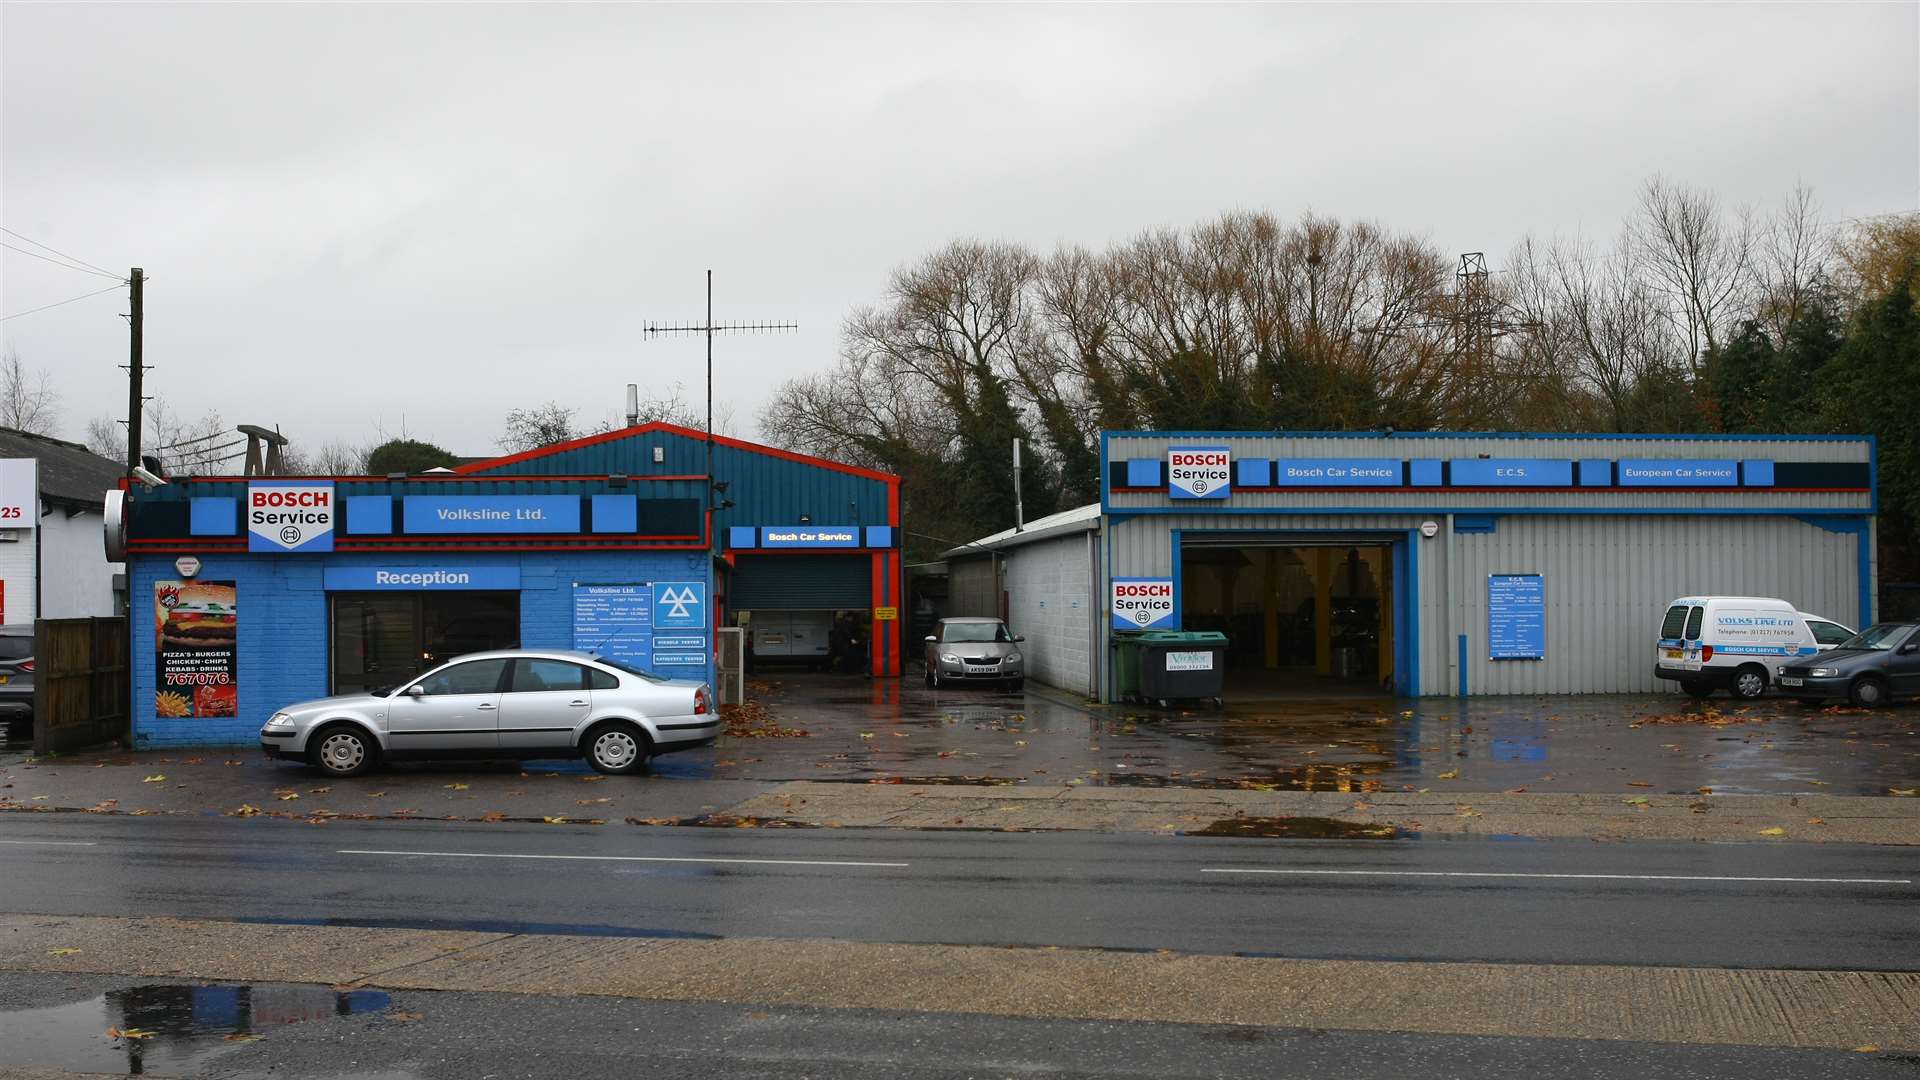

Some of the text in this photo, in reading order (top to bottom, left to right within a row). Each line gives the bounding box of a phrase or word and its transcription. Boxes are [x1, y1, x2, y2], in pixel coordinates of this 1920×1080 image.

[1172, 454, 1228, 466] BOSCH
[1172, 467, 1228, 480] Service
[1287, 467, 1393, 478] Bosch Car Service
[1496, 468, 1528, 478] E.C.S.
[1625, 468, 1732, 480] European Car Service
[252, 492, 328, 507] BOSCH
[1, 507, 21, 518] 25
[252, 510, 329, 525] Service
[437, 507, 546, 521] Volksline Ltd.
[768, 532, 852, 542] Bosch Car Service
[376, 570, 469, 587] Reception
[1116, 586, 1170, 597] BOSCH
[1116, 599, 1170, 610] Service
[1718, 617, 1752, 626] VOLKS
[1754, 618, 1777, 626] LINE
[165, 672, 229, 686] 767076
